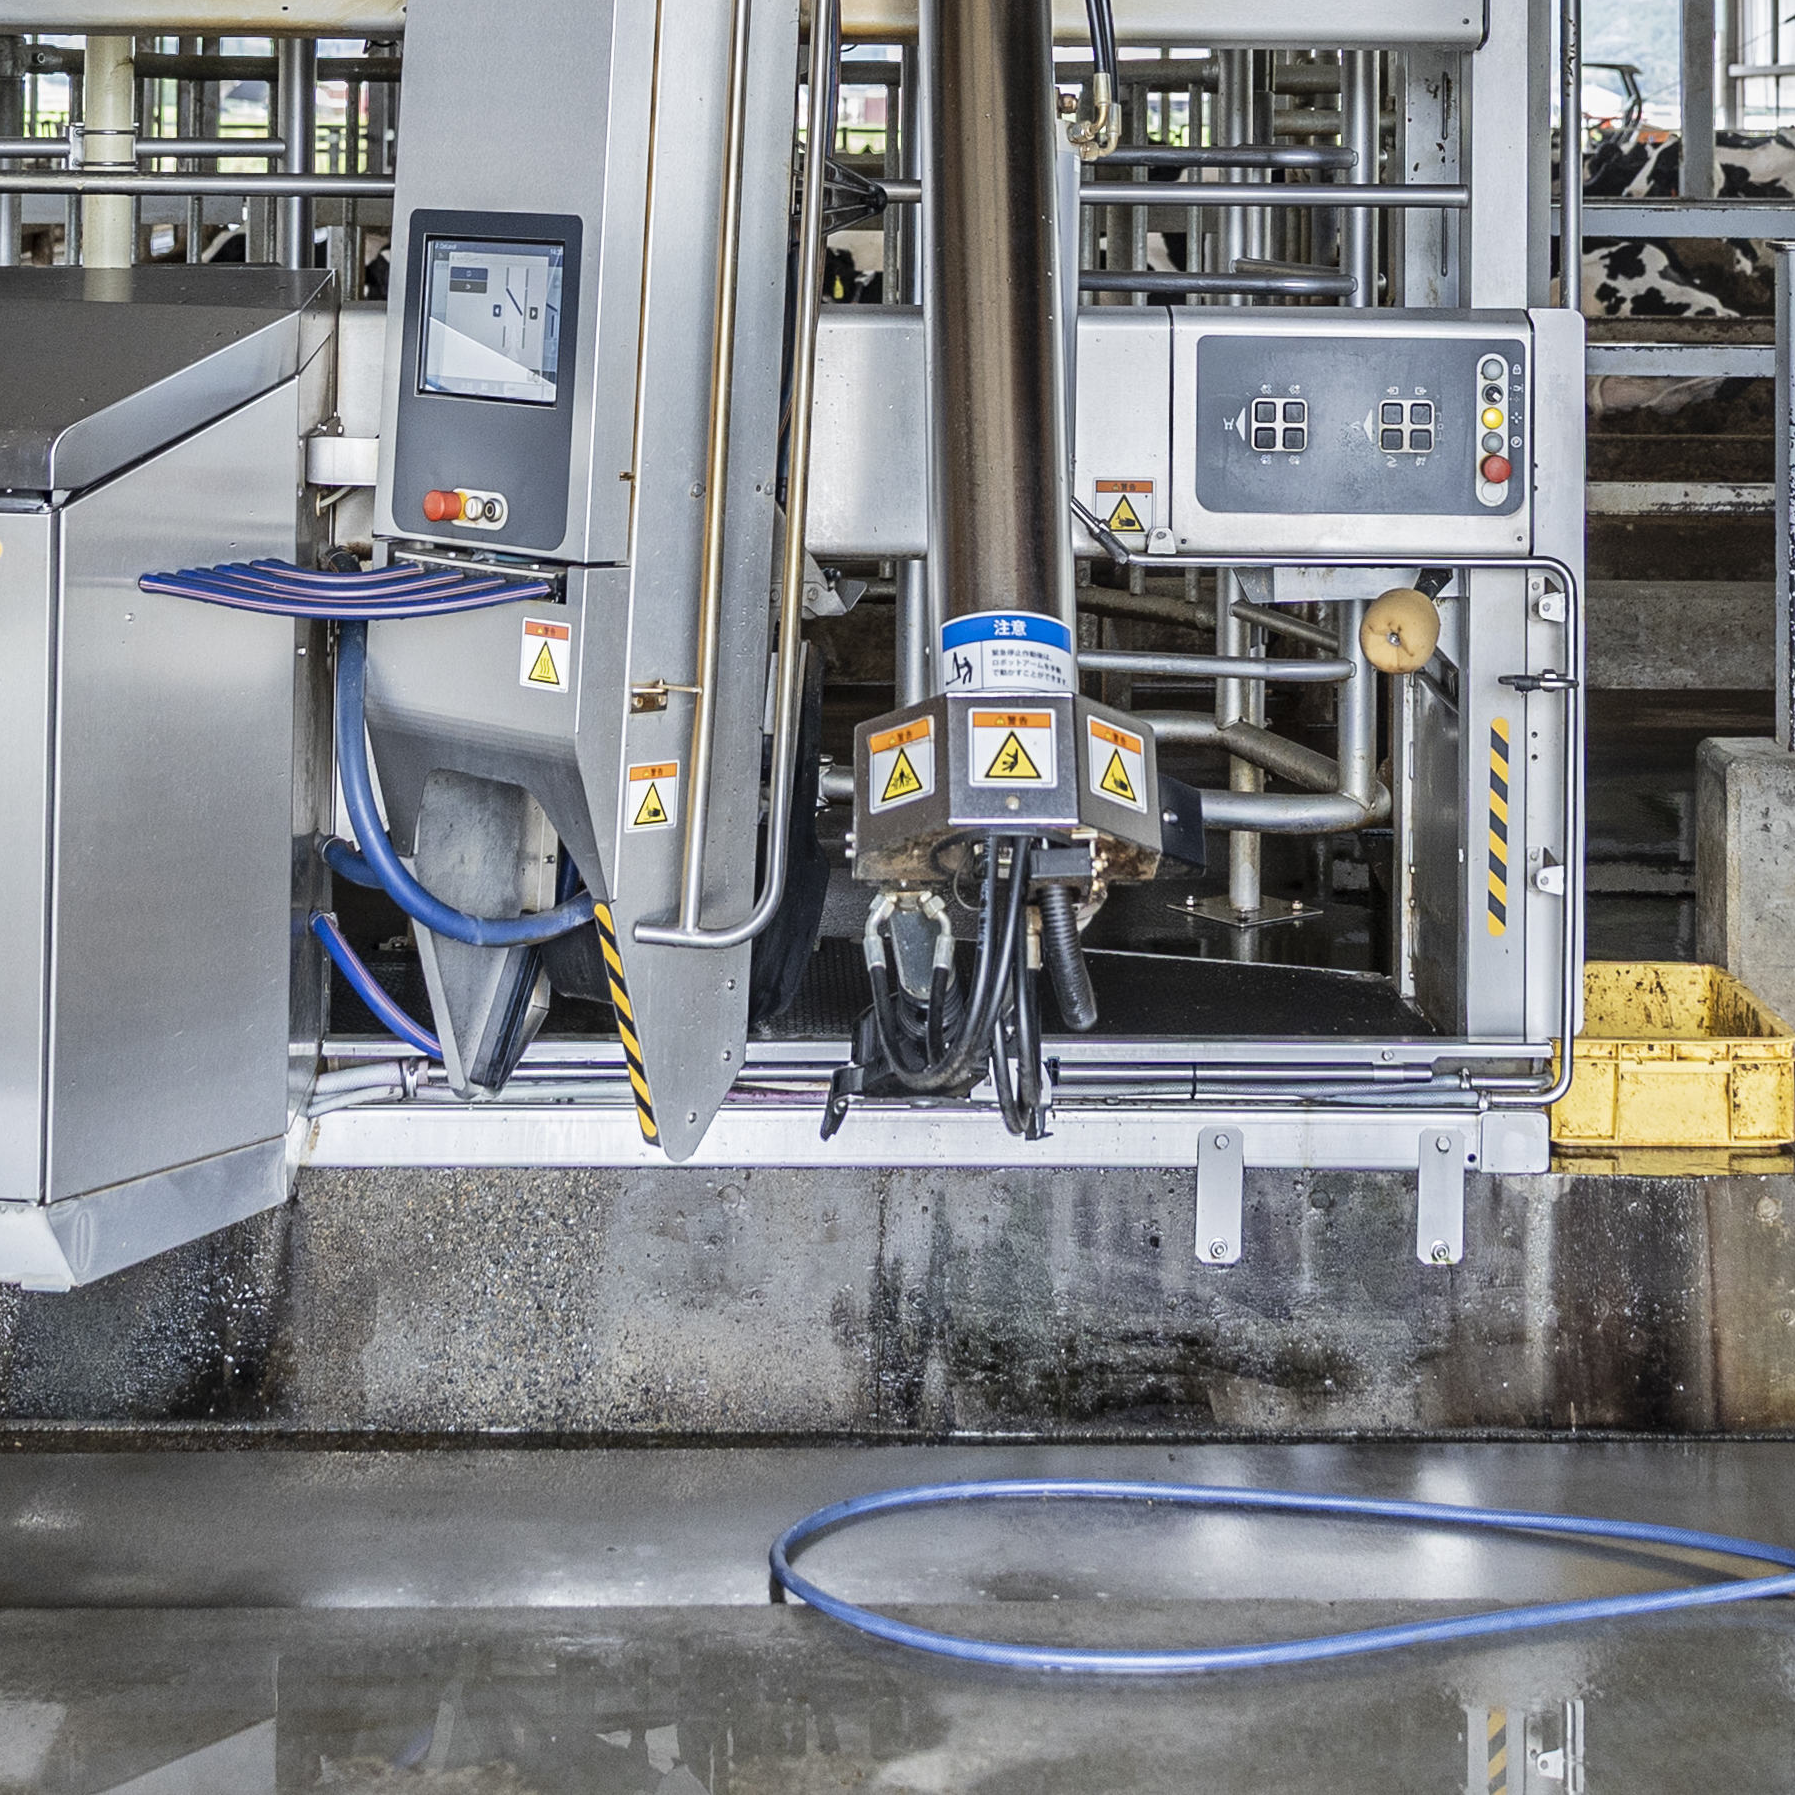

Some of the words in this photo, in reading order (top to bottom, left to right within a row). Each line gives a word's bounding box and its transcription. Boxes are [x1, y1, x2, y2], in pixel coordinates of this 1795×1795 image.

[993, 618, 1027, 637] 注意
[992, 659, 1062, 674] ロボットアームを手動
[1007, 716, 1028, 726] 警告
